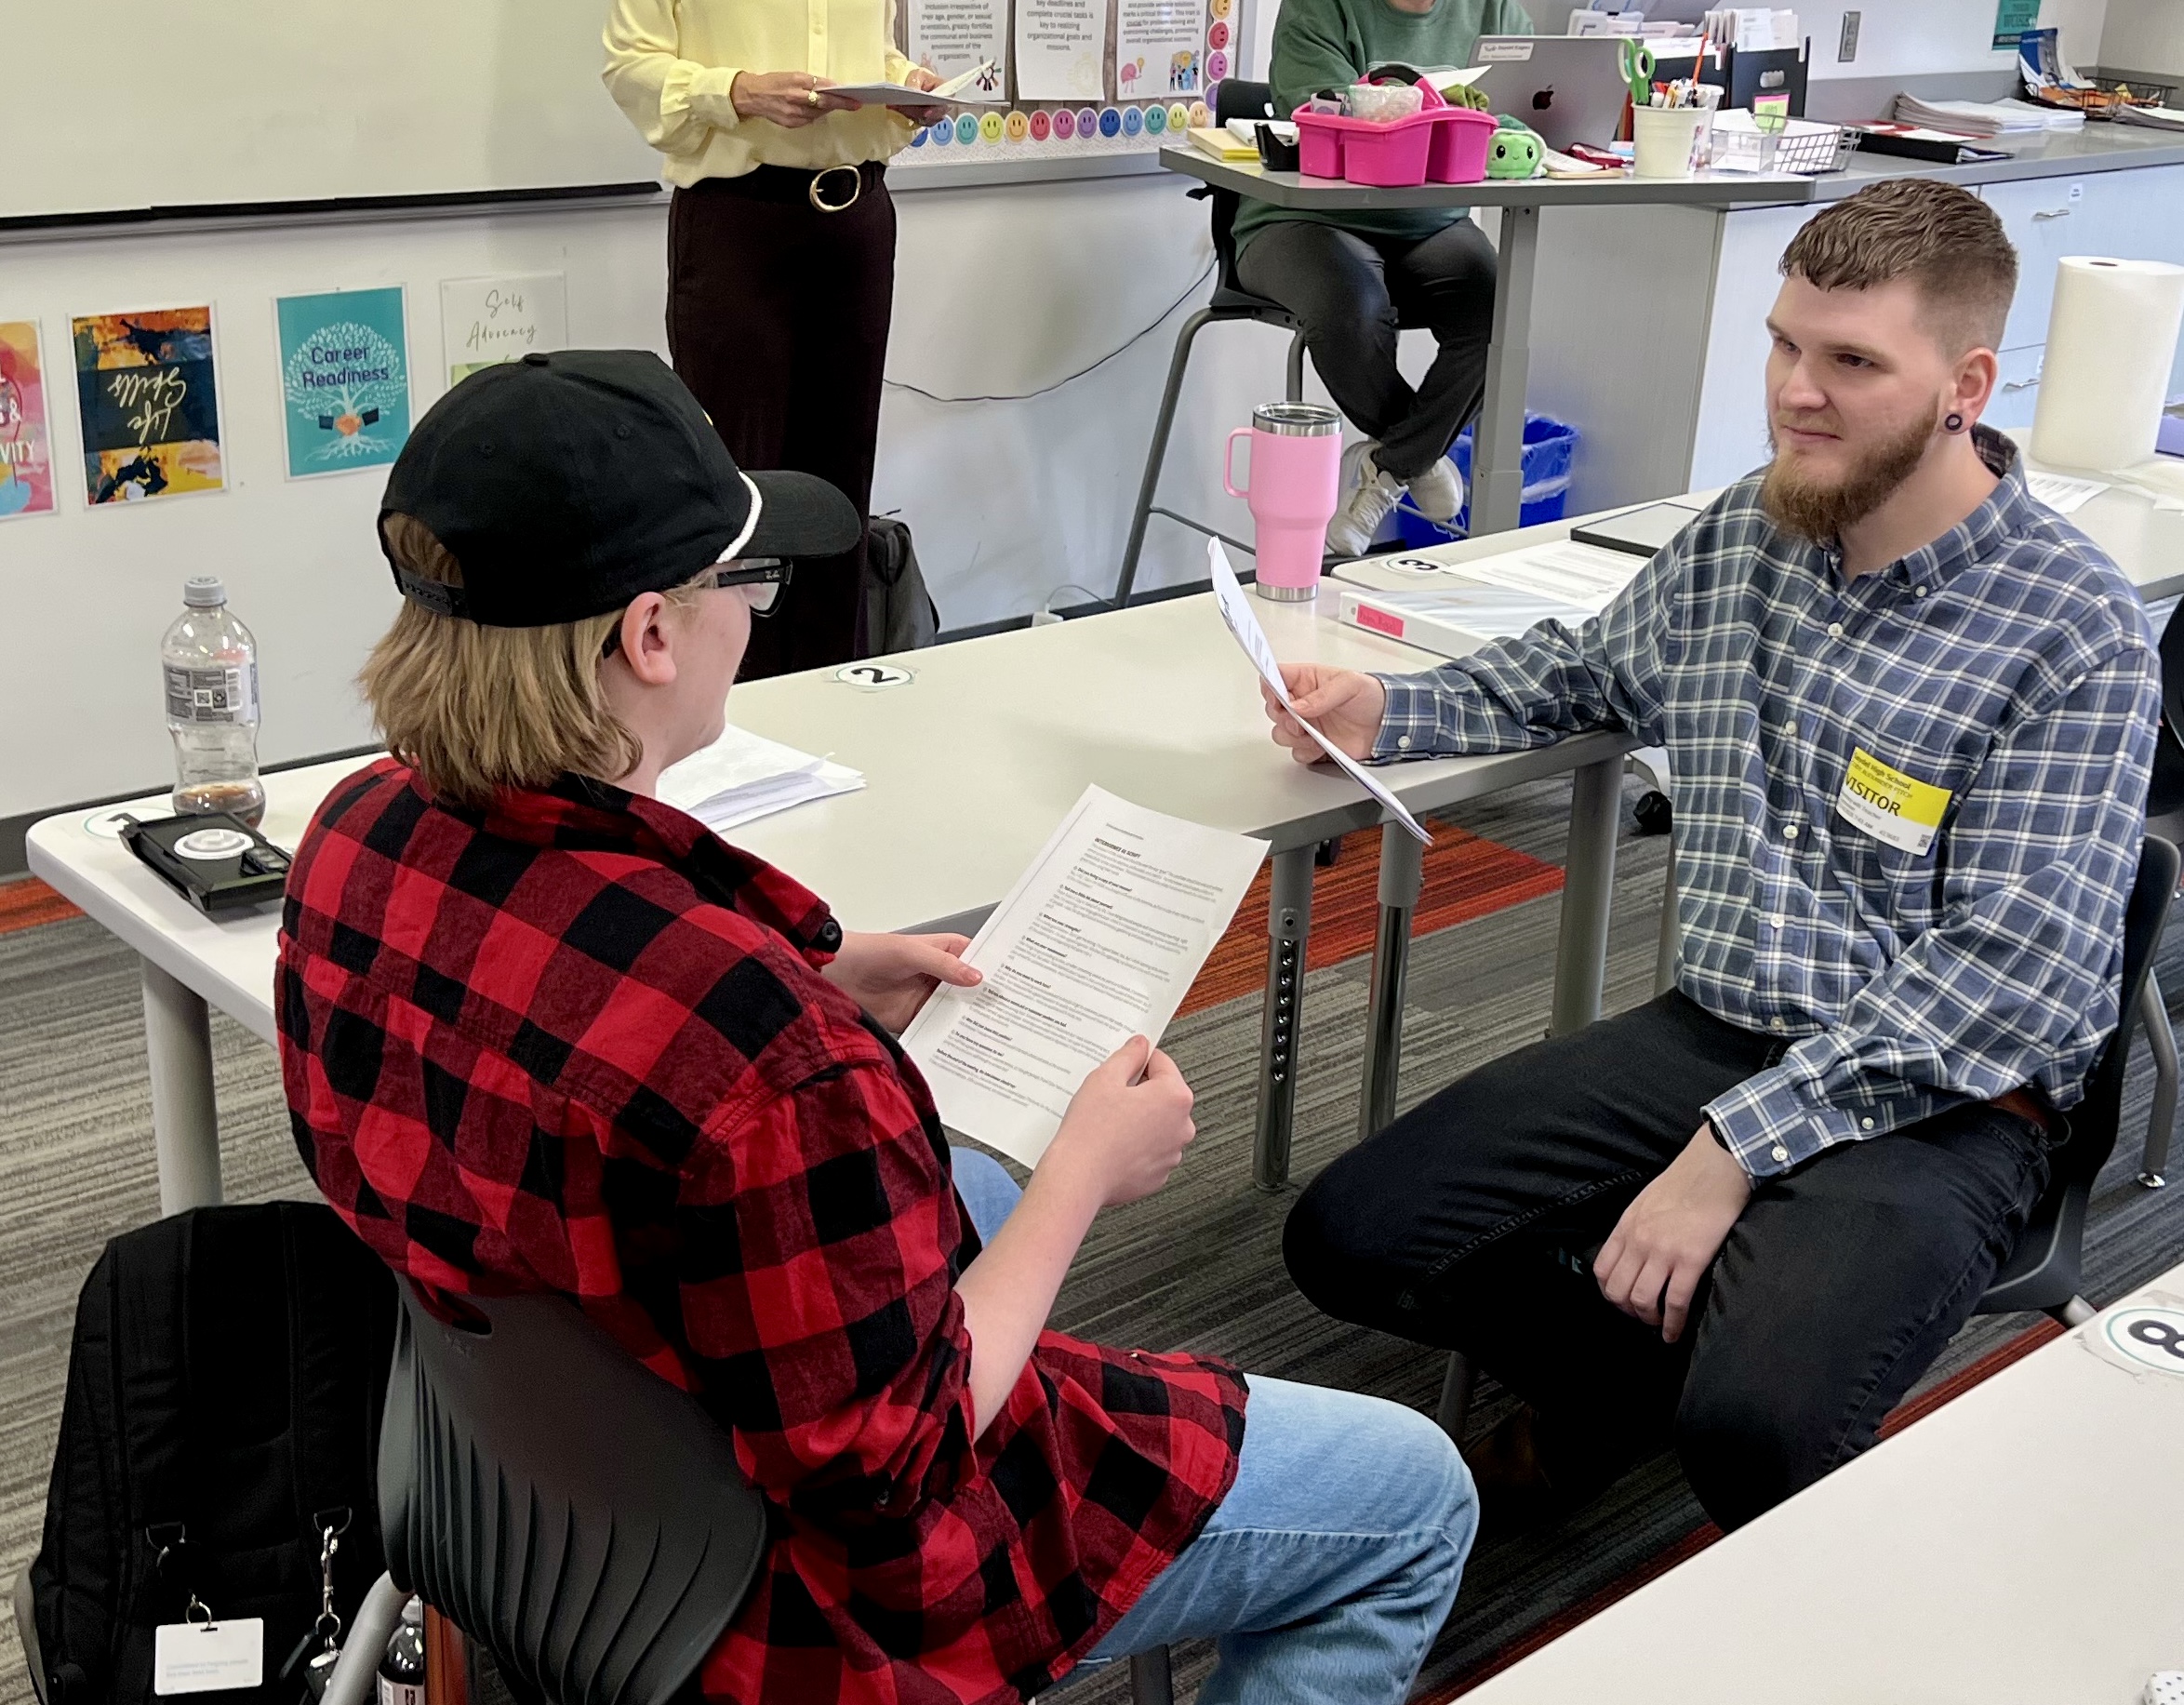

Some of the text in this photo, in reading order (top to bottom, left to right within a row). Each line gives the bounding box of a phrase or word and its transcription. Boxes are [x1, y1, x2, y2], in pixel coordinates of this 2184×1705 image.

[486, 289, 525, 319] Self
[466, 321, 537, 352] Advocacy
[312, 346, 370, 364] Career
[107, 366, 186, 408] Skills
[302, 366, 389, 388] Readiness
[127, 400, 172, 445] Life
[1397, 558, 1439, 571] 3
[851, 667, 899, 684] 2
[1845, 773, 1901, 817] VISITOR
[1886, 772, 1912, 791] School
[2127, 1319, 2184, 1359] 8
